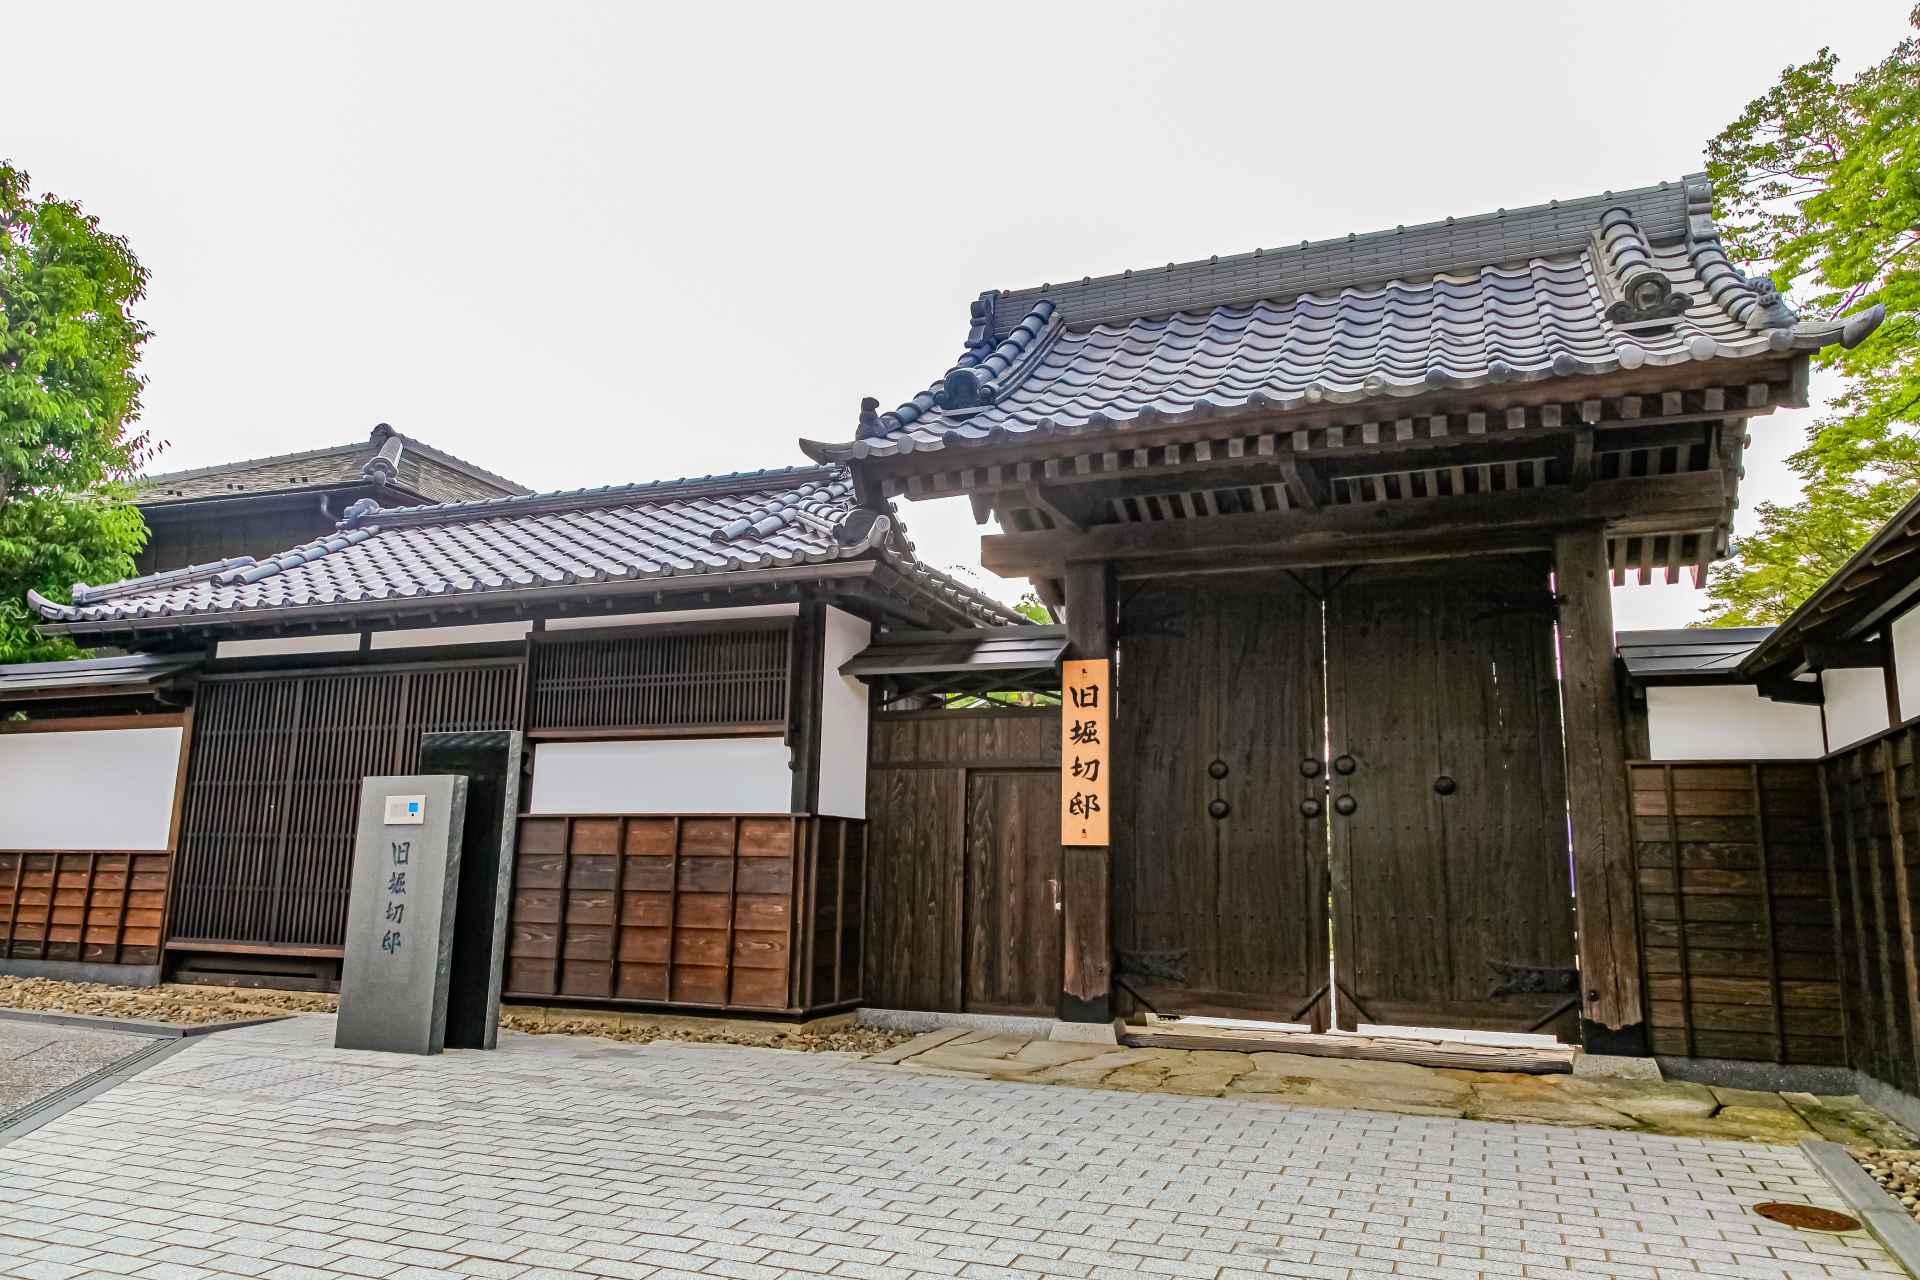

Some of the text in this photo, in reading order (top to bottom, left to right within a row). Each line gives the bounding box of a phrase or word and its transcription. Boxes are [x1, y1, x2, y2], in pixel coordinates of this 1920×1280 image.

[1069, 684, 1101, 820] 旧堀切邸
[381, 841, 411, 955] 旧堀切邸
